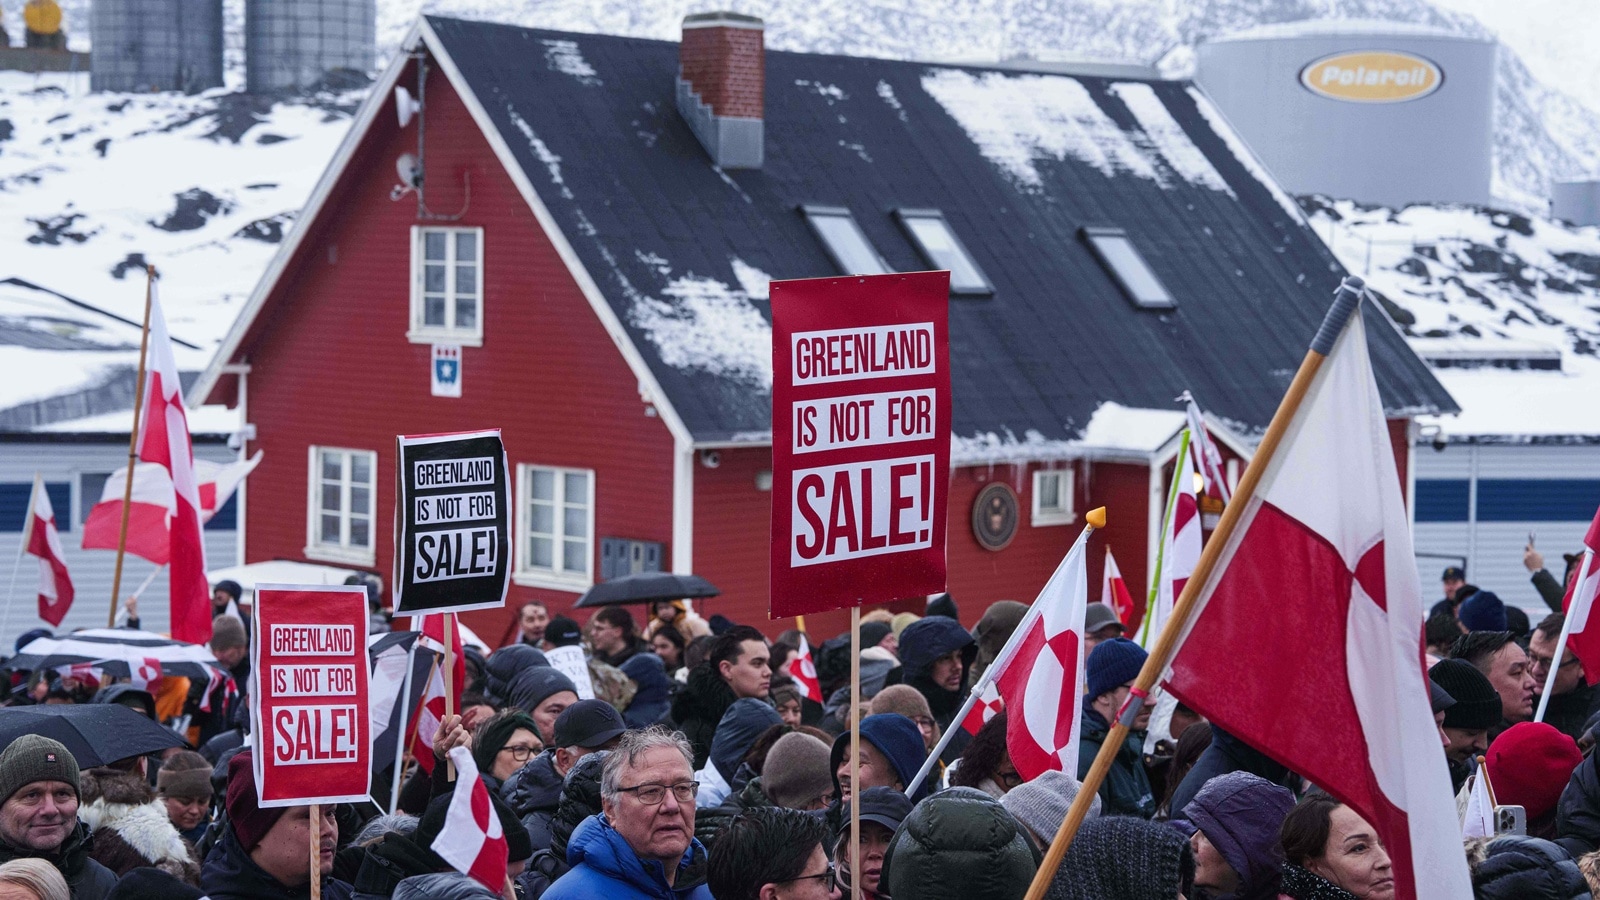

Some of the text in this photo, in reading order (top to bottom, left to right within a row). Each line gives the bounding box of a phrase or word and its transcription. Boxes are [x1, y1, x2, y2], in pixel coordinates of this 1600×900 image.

[1321, 66, 1427, 86] Polaroil
[796, 329, 931, 379] GREENLAND
[797, 395, 931, 447] IS NOT FOR
[417, 460, 492, 486] GREENLAND
[417, 495, 493, 521] IS NOT FOR
[796, 461, 931, 559] SALE!
[416, 530, 495, 580] SALE!
[273, 627, 353, 652] GREENLAND
[273, 667, 354, 693] IS NOT FOR
[275, 708, 356, 762] SALE!
